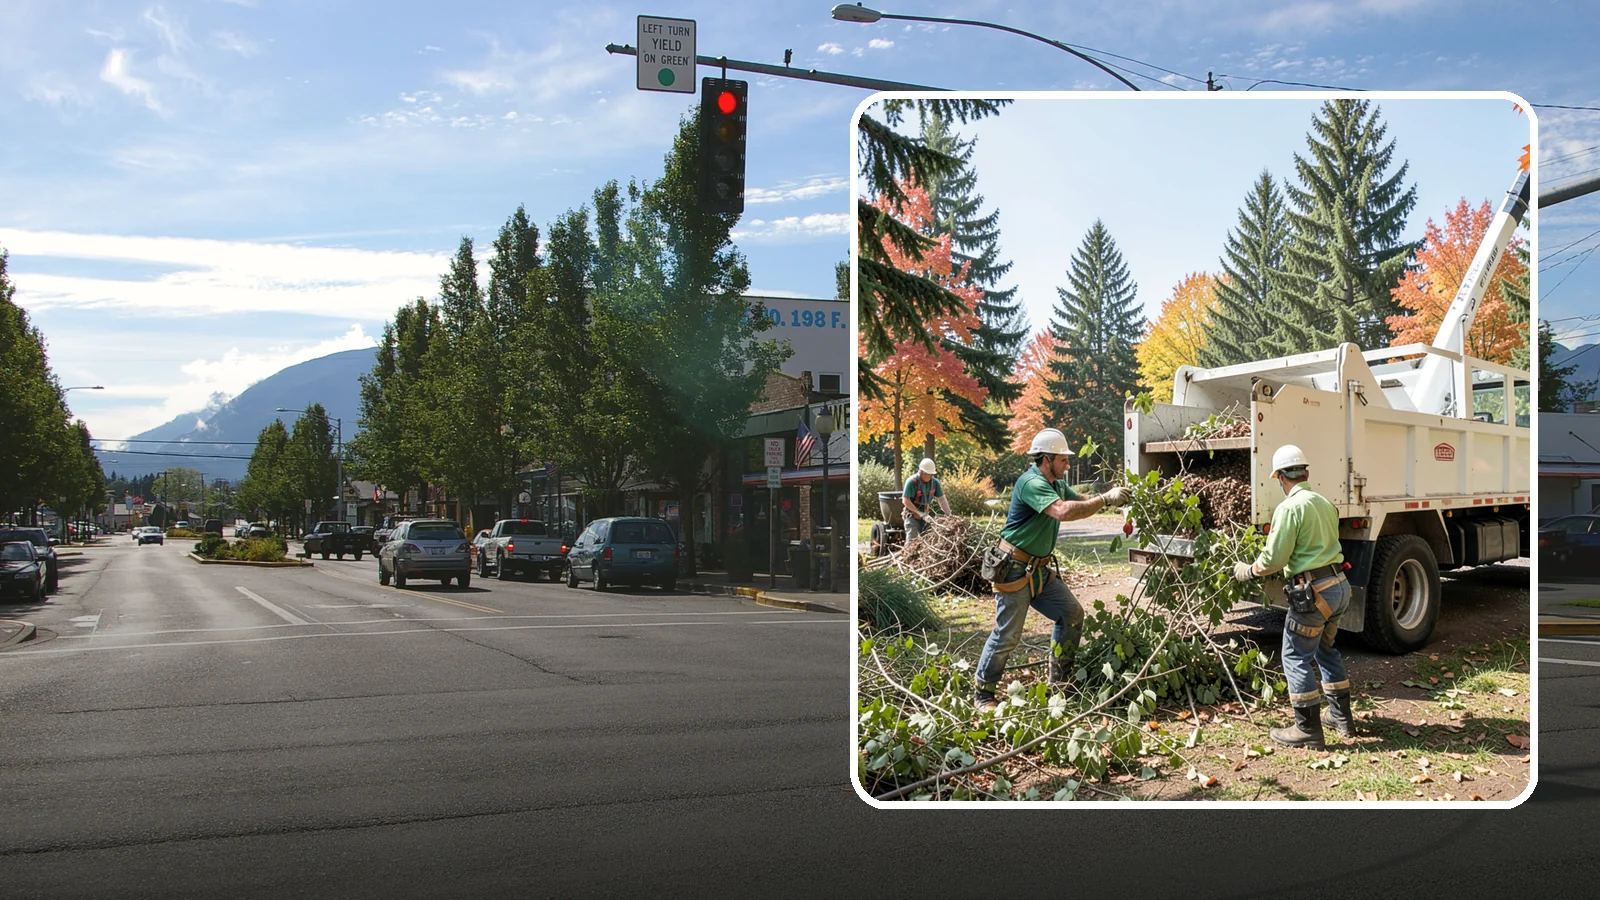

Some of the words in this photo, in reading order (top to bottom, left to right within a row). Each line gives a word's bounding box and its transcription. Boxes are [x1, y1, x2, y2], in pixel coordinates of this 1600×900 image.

[643, 23, 663, 34] LEFT
[668, 25, 690, 36] TURN
[652, 38, 682, 52] YIELD
[644, 53, 656, 64] ON
[661, 55, 689, 66] GREEN
[791, 309, 826, 328] 198
[831, 311, 847, 329] F.
